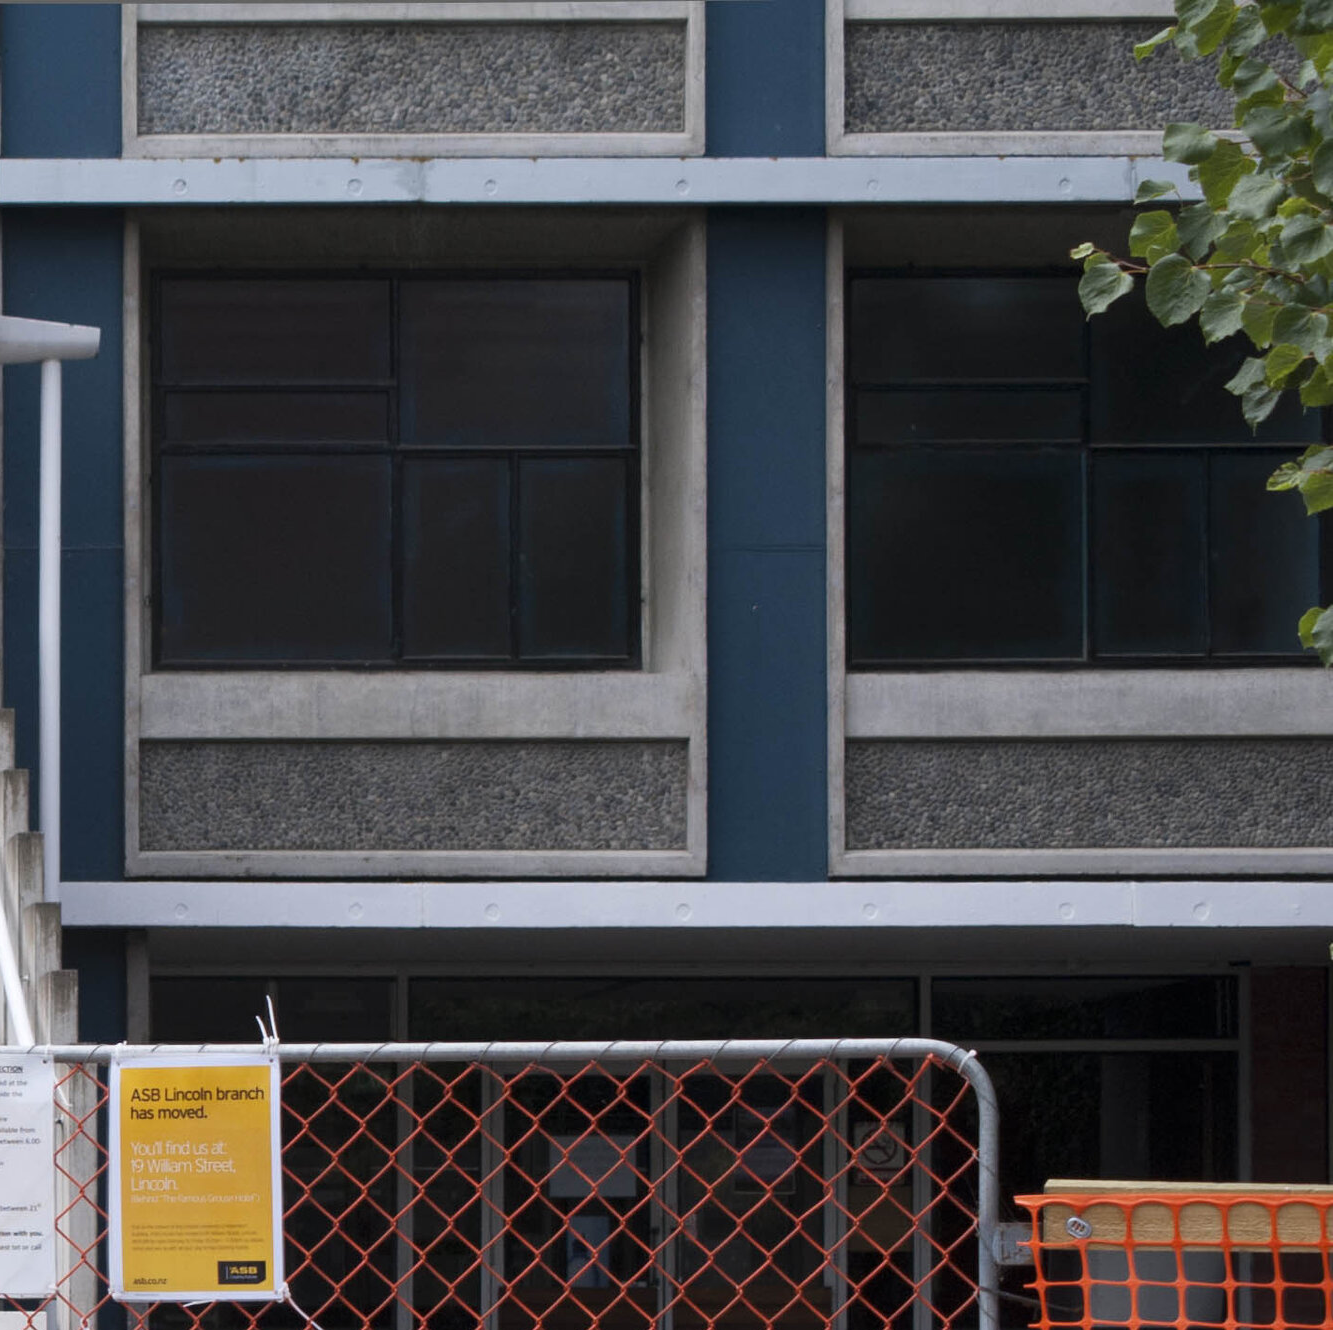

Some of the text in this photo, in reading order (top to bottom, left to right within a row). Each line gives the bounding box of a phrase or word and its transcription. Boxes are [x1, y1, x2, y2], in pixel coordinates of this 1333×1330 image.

[131, 1086, 265, 1102] ASB Lincoln branch
[130, 1105, 208, 1120] has moved.
[166, 1140, 190, 1155] find
[193, 1144, 208, 1155] us
[130, 1159, 144, 1173] 19
[147, 1158, 192, 1173] William
[229, 1266, 258, 1275] ASB
